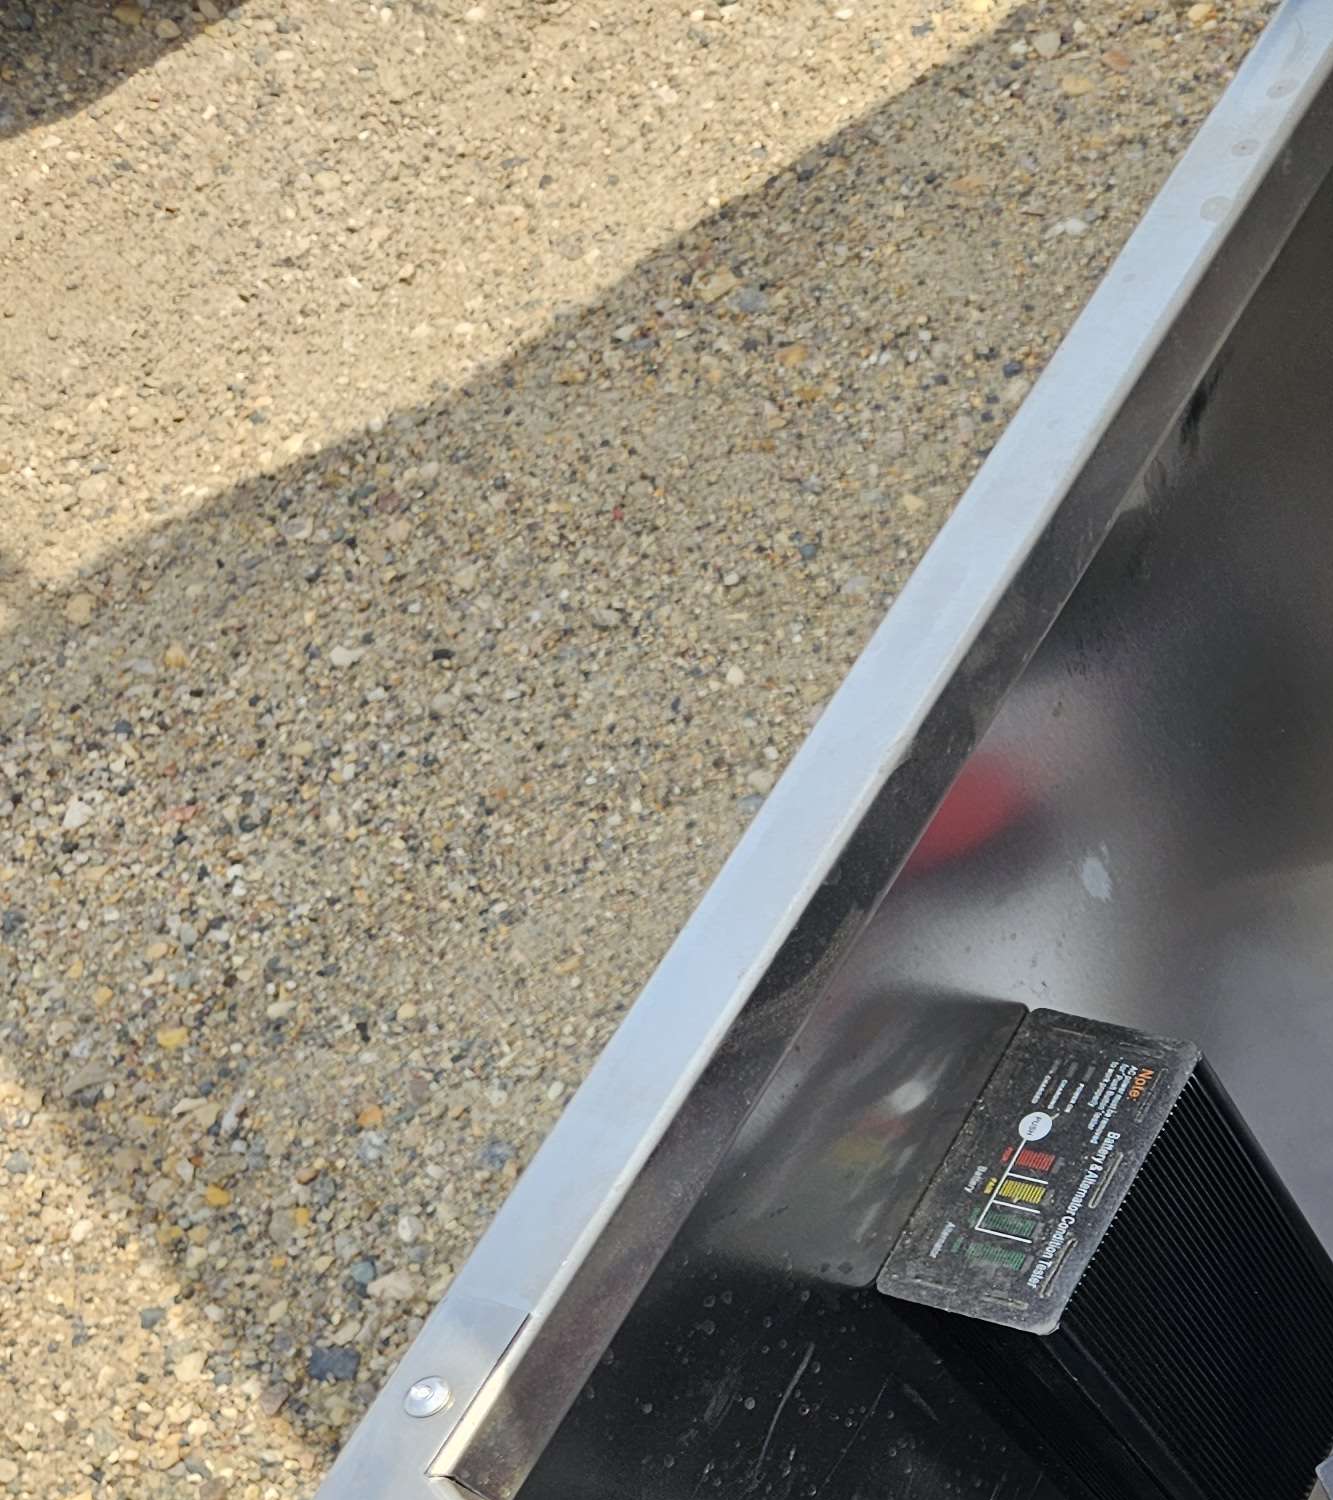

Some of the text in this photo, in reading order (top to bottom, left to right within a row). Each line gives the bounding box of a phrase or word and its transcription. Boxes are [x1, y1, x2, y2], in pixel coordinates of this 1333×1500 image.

[1124, 1067, 1155, 1103] Note:
[1024, 1115, 1043, 1137] PUSH
[1024, 1129, 1121, 1289] Battery & Alternator Condition Tester
